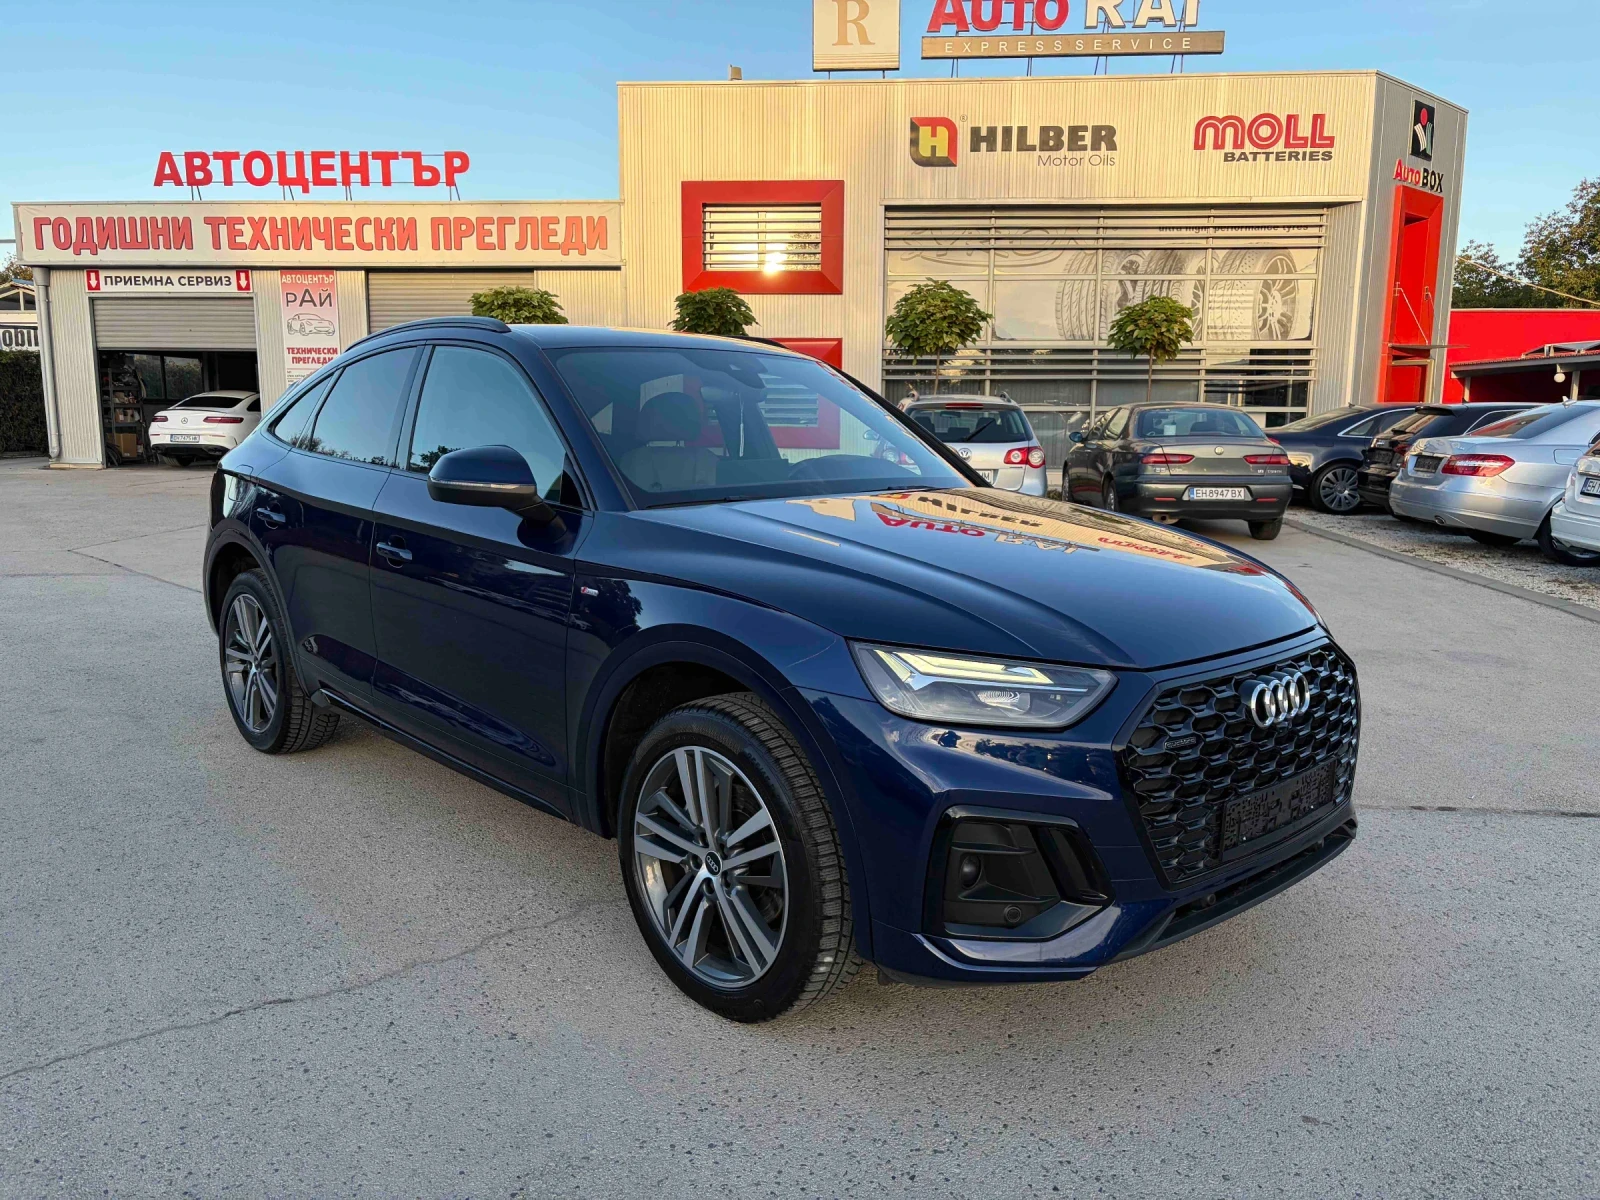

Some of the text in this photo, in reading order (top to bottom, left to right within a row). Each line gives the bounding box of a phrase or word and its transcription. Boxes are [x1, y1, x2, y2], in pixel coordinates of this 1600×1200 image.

[831, 0, 875, 46] R
[945, 37, 1191, 53] EXPRESS SERVICE
[970, 125, 1117, 152] HILBER
[1037, 154, 1116, 166] Motor Oils
[1223, 151, 1333, 162] BATTERIES
[153, 150, 470, 194] АВТОЦЕНТЪР
[33, 216, 607, 255] ГОДИШНИ ТЕХНИЧЕСКИ ПРЕГЛЕДИ
[104, 275, 232, 287] ПРИЕМНА СЕРВИЗ
[281, 274, 334, 285] АВТОЦЕНТЪР
[286, 347, 338, 355] ТЕХНИЧЕСКИ
